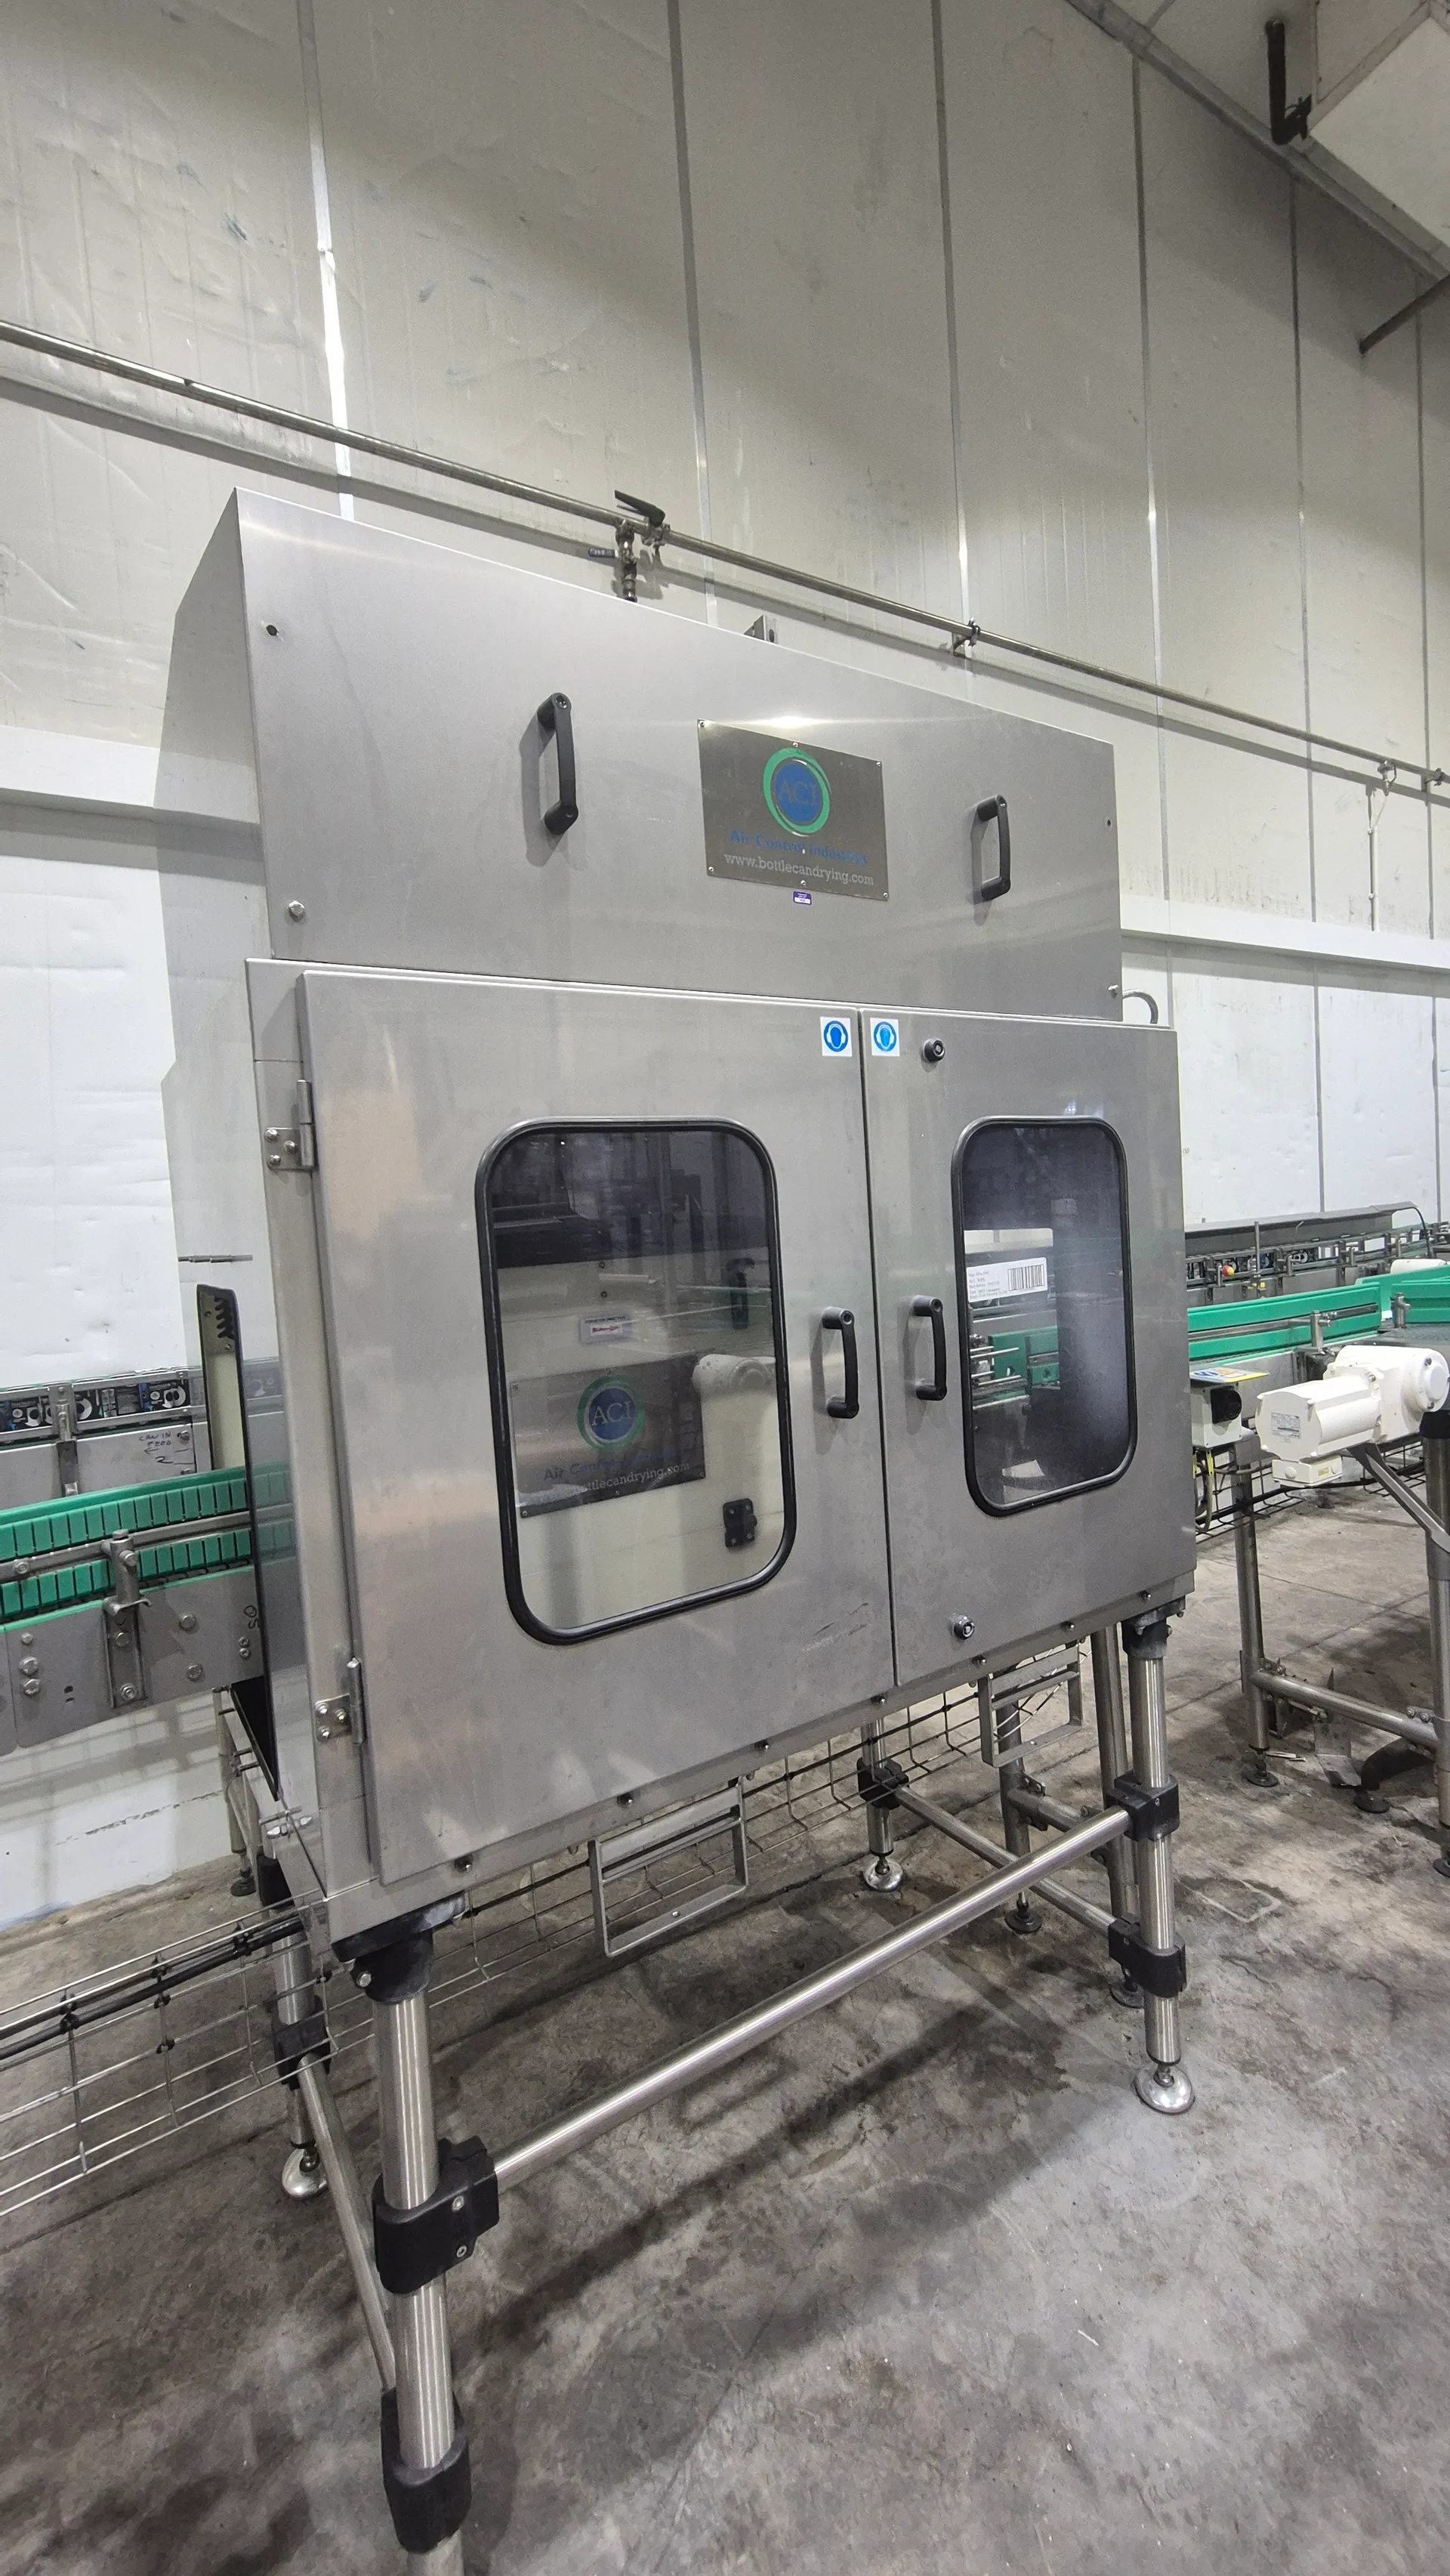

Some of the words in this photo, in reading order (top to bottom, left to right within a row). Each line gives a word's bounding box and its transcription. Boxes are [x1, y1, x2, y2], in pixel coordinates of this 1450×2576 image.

[778, 780, 817, 807] ACI
[730, 829, 750, 845] Air
[723, 854, 875, 885] www.bottlecandrying.com
[591, 1401, 633, 1426] ACI
[543, 1467, 563, 1482] Air
